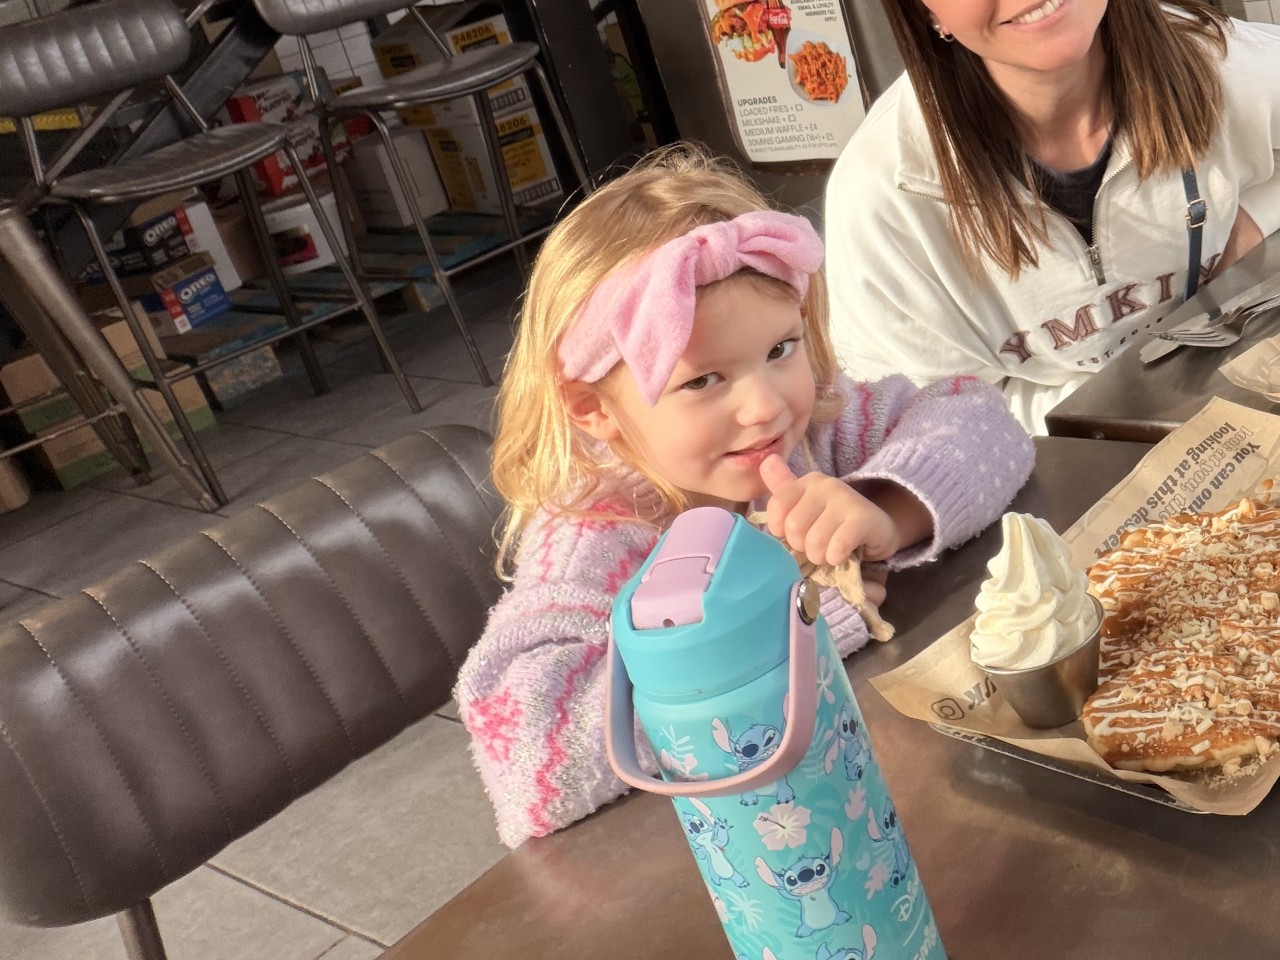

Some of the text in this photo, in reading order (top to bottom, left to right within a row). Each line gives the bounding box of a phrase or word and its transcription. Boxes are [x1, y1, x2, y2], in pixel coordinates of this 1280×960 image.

[737, 95, 777, 107] UPGRADES
[739, 107, 768, 117] LOADED
[769, 104, 789, 114] FRIES
[795, 103, 803, 112] £3
[741, 116, 780, 127] MILKSHAKE
[787, 114, 797, 122] £3
[744, 127, 774, 137] MEDIUM
[775, 124, 804, 134] WAFFLE
[809, 123, 818, 131] £4
[775, 134, 805, 145] GAMING
[143, 215, 177, 247] OREO
[180, 273, 216, 304] OREO
[1185, 421, 1237, 465] looking
[1222, 425, 1254, 452] look
[1208, 448, 1227, 468] at
[1232, 441, 1261, 464] You
[1173, 459, 1191, 479] at
[1210, 462, 1236, 490] can
[1146, 474, 1179, 509] this
